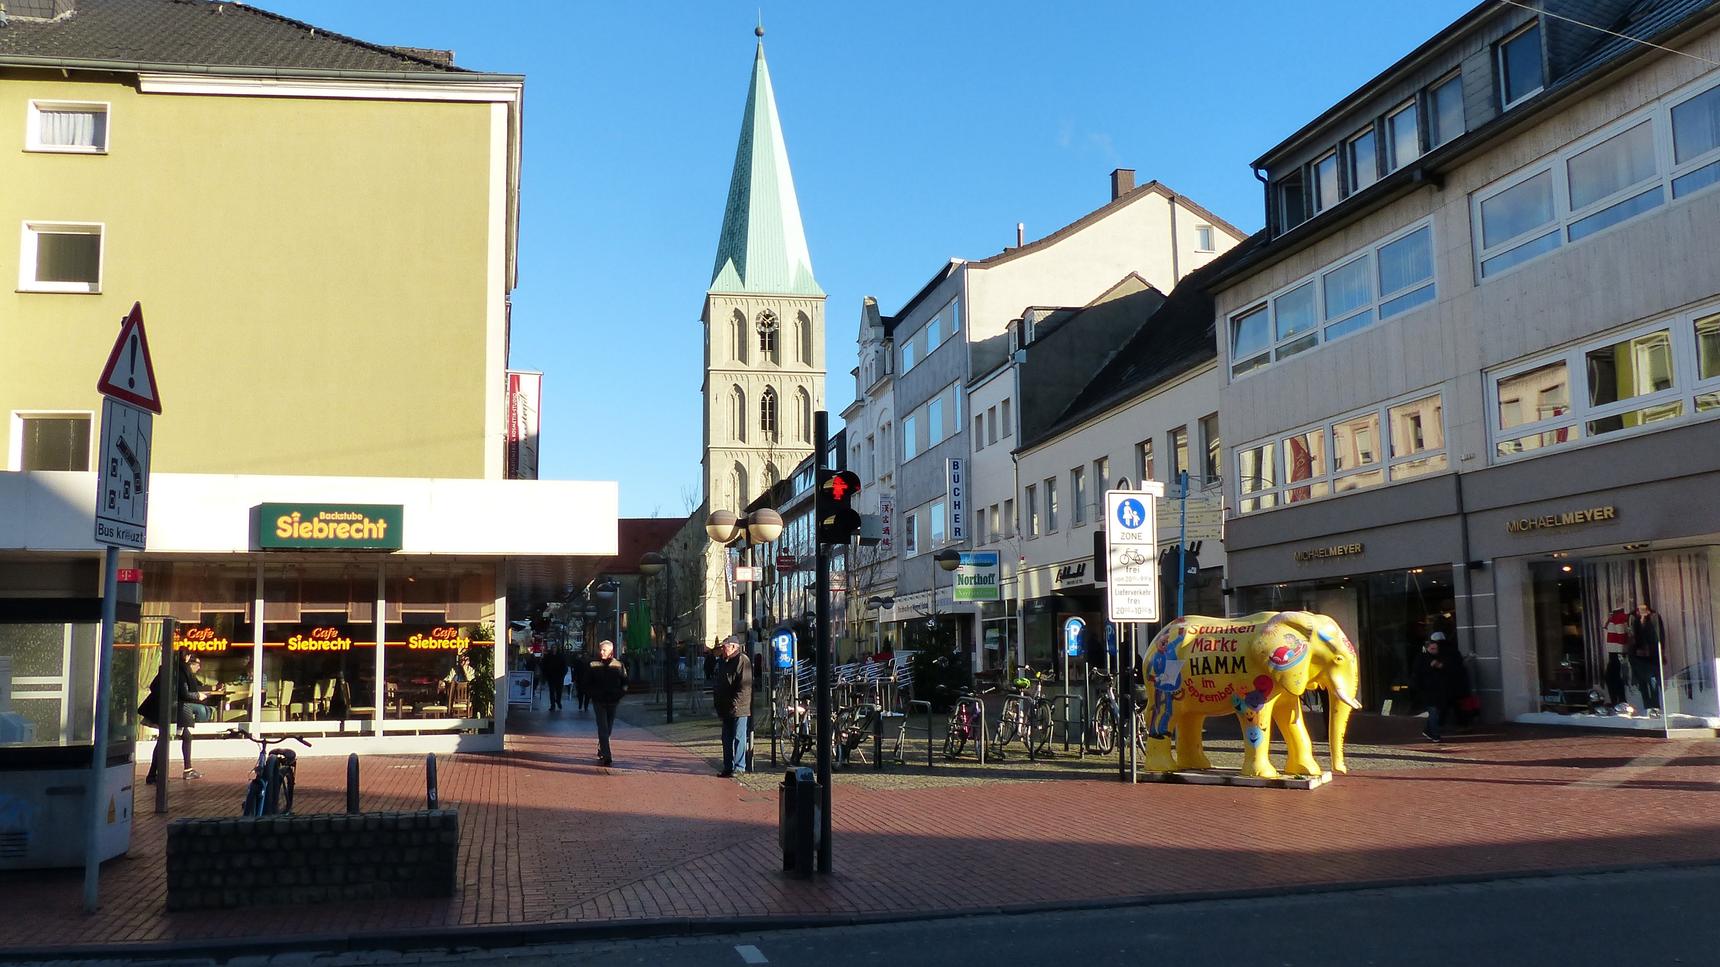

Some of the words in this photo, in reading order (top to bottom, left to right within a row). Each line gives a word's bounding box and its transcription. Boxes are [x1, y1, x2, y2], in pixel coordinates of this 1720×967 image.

[952, 460, 962, 537] BÜCHER
[319, 511, 363, 520] Backstube
[276, 512, 387, 539] Siebrecht
[98, 523, 114, 538] Bus
[116, 527, 144, 543] kreuzt
[1120, 532, 1143, 541] ZONE
[1126, 565, 1140, 574] frei
[957, 573, 995, 586] Northoff
[1114, 588, 1152, 596] Lieferverkehr
[1127, 597, 1141, 605] frei
[187, 628, 214, 640] Cafe
[312, 627, 339, 639] Cafe
[432, 626, 458, 639] Cafe
[1188, 624, 1256, 635] Stuniken
[288, 635, 351, 650] Siebrecht
[409, 634, 470, 649] Siebrecht
[1191, 637, 1238, 653] Markt
[1189, 656, 1248, 676] HAMM
[1202, 677, 1215, 688] im
[1184, 678, 1235, 703] September
